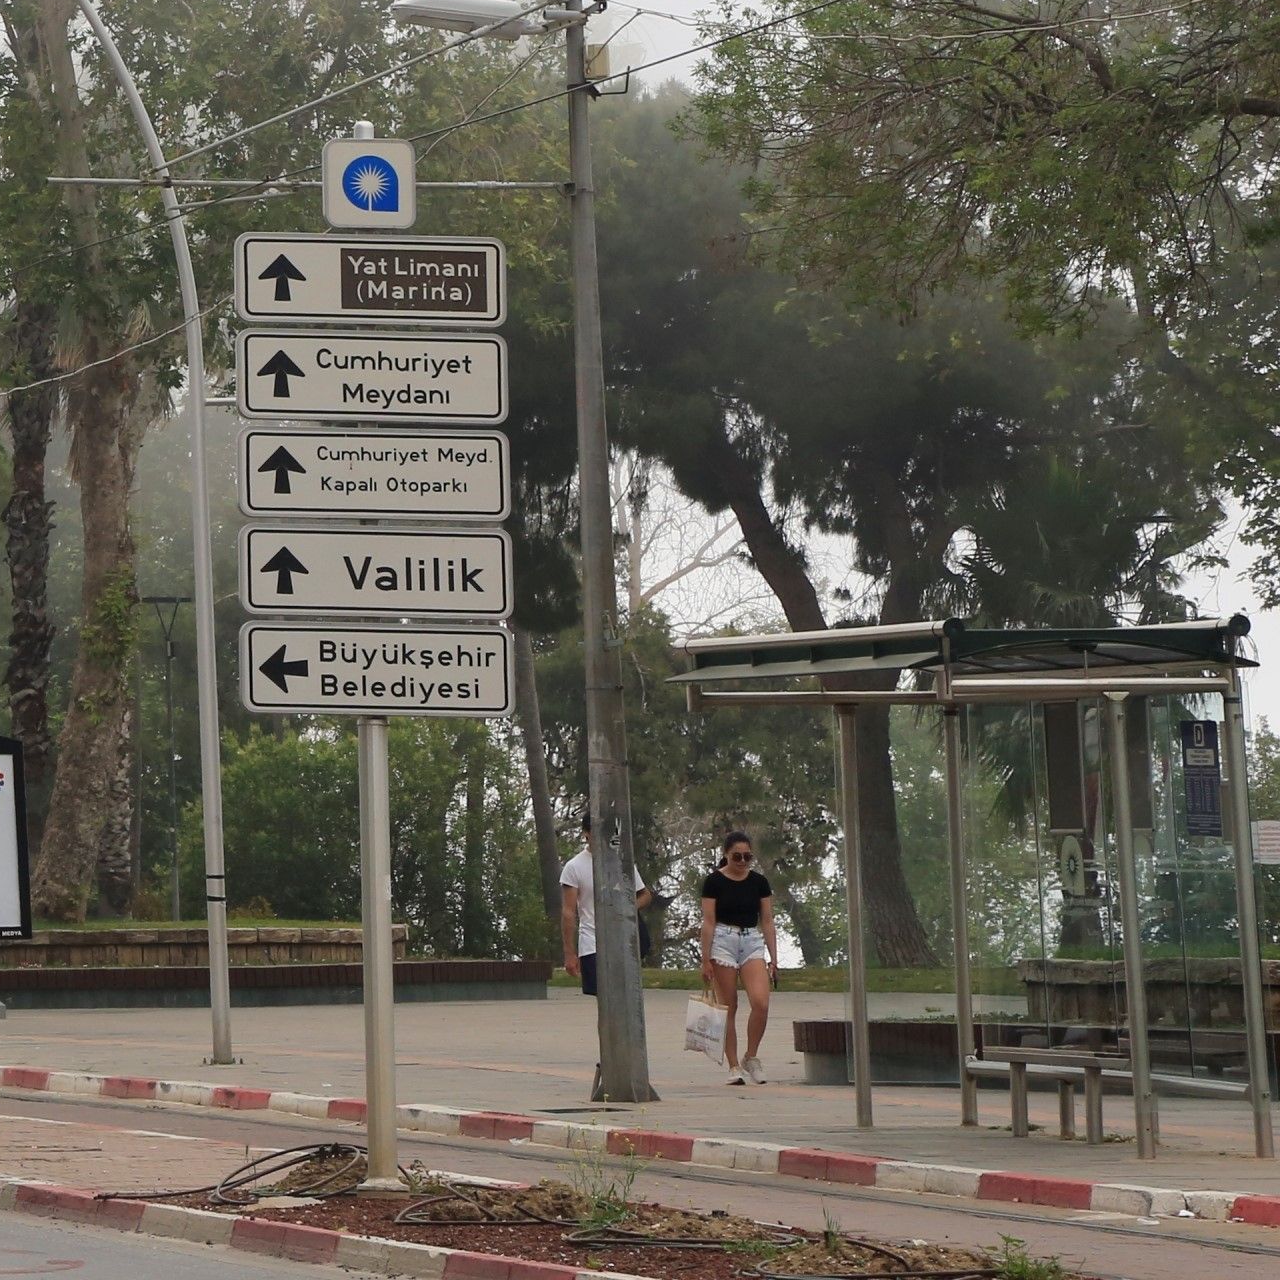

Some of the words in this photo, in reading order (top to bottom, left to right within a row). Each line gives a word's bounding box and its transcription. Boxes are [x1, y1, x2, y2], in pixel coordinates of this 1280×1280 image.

[347, 256, 388, 276] Yat
[395, 256, 479, 277] Limanı
[356, 281, 473, 303] (Marina)
[316, 348, 472, 378] Cumhuriyet
[342, 384, 450, 412] Meydanı
[316, 446, 427, 468] Cumhuriyet
[438, 447, 493, 468] Meyd.
[320, 476, 377, 495] Kapalı
[387, 477, 468, 497] Otoparkı
[344, 554, 485, 593] Valilik
[319, 640, 496, 669] Büyükşehir
[320, 674, 480, 704] Belediyesi
